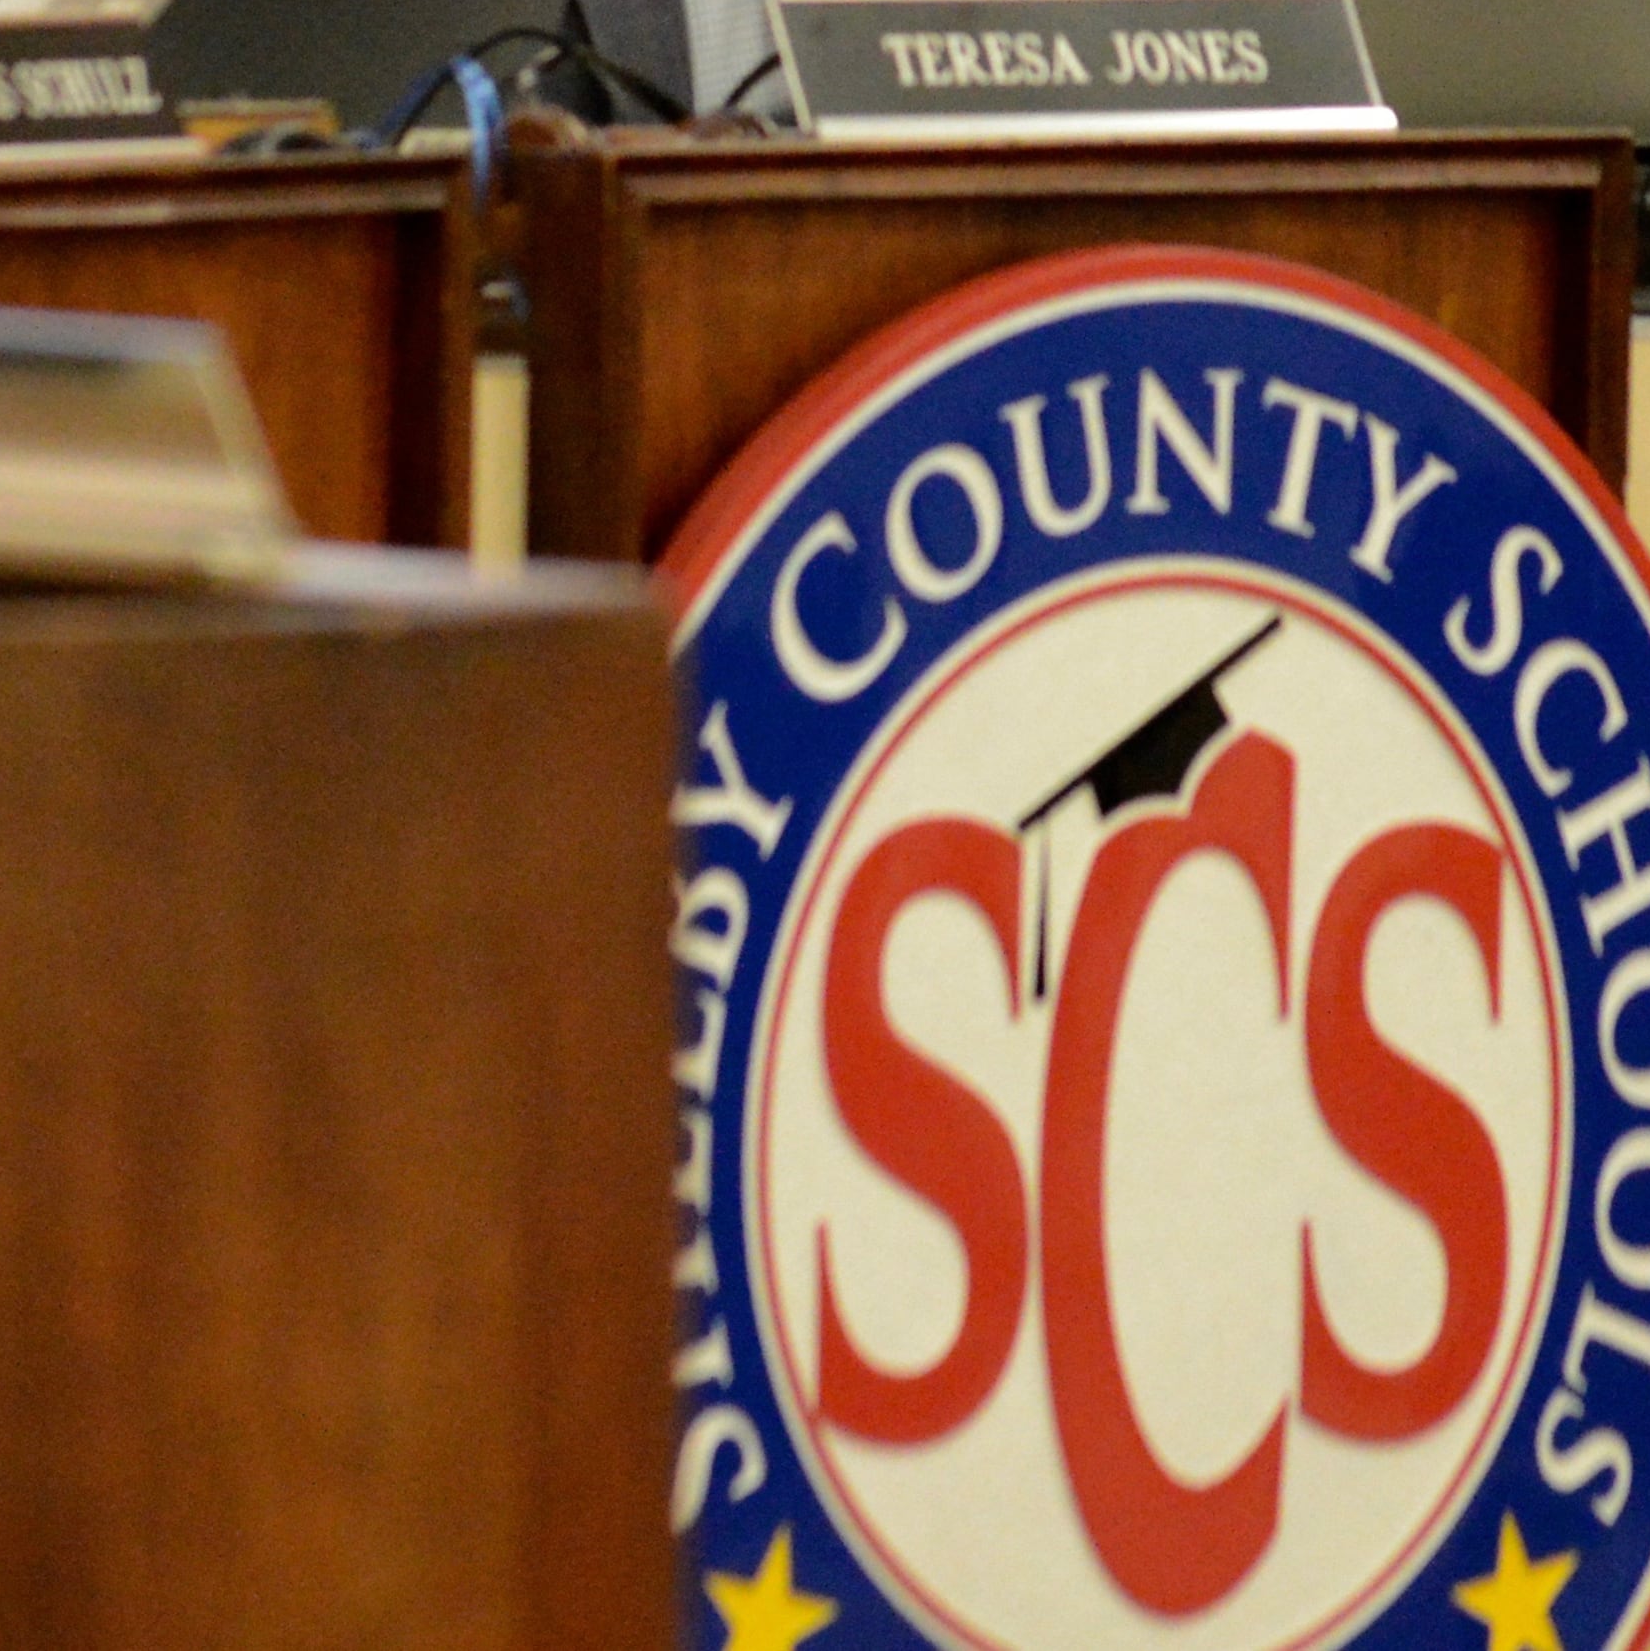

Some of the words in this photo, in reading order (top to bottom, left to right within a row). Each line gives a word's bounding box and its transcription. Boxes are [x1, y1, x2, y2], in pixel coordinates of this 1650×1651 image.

[880, 32, 1090, 88] TERESA
[1107, 30, 1268, 86] JONES
[767, 367, 1459, 704] COUNTY
[813, 726, 1512, 1626] SCS
